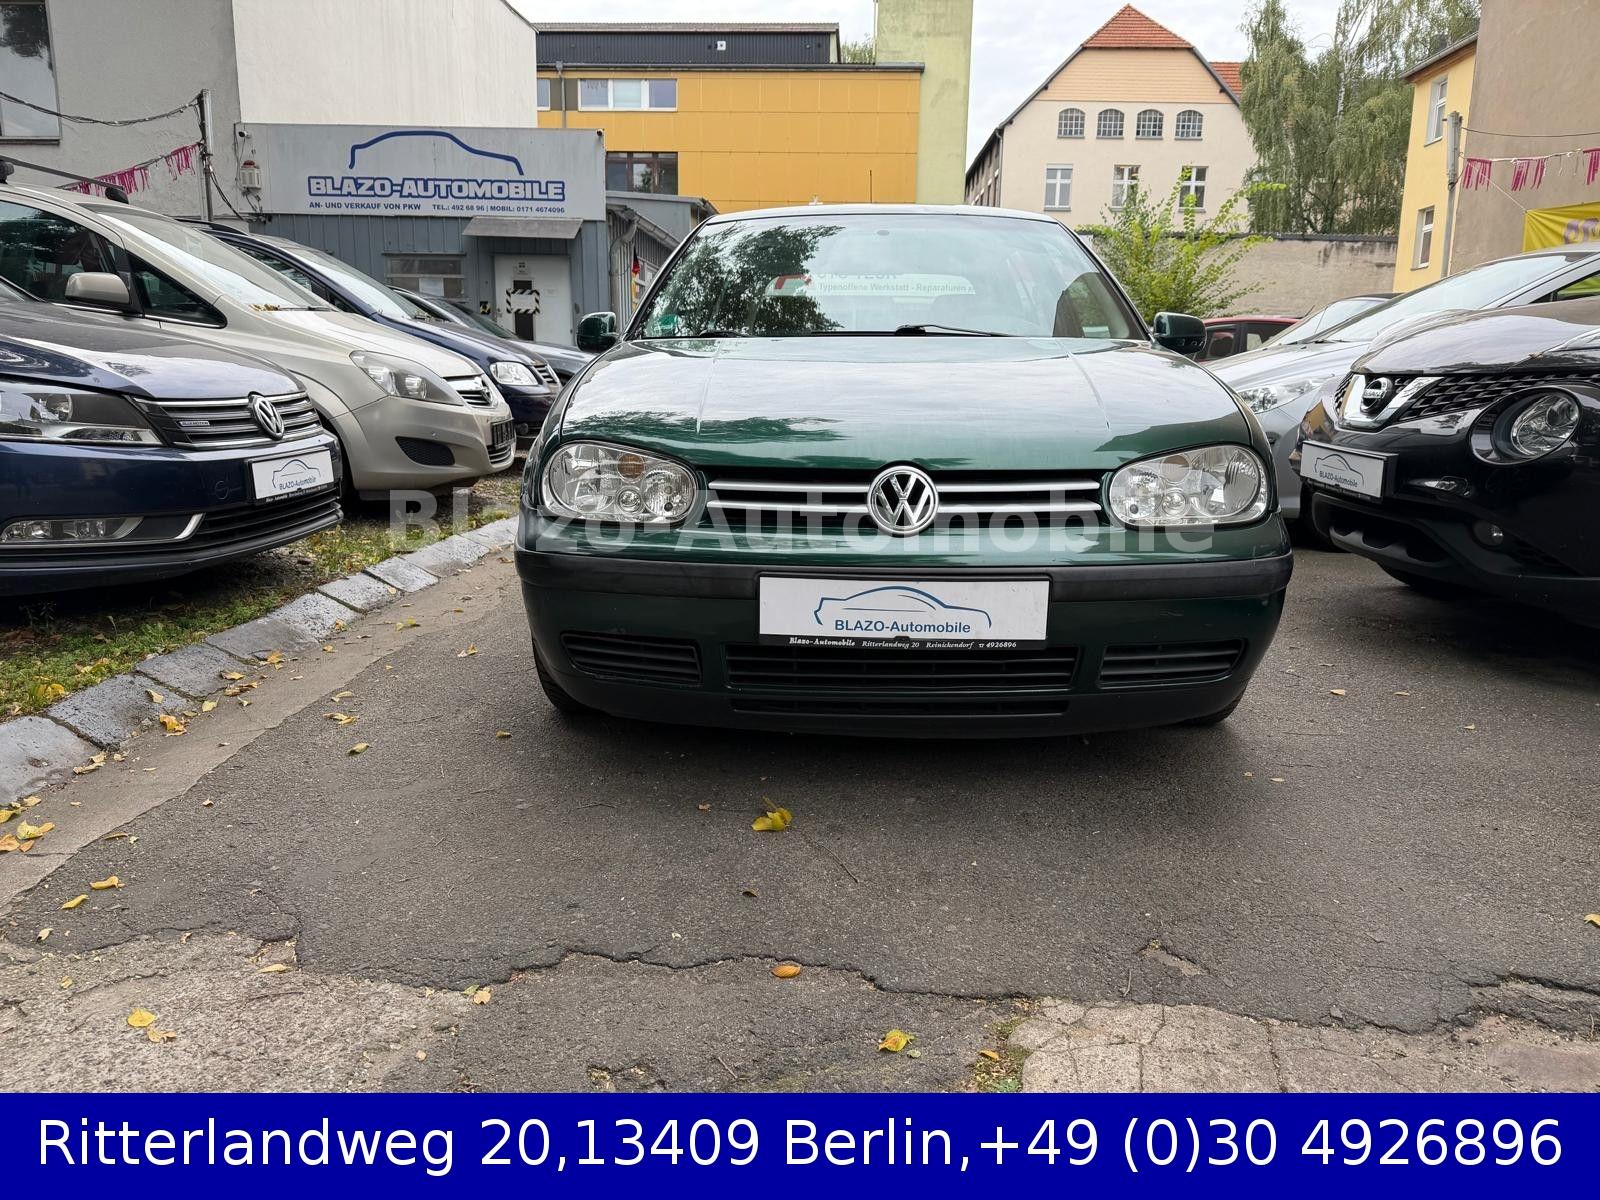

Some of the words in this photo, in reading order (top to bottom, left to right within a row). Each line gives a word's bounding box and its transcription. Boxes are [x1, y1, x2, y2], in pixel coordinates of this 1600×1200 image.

[308, 176, 565, 201] BLAZO-AUTOMOBILE
[344, 202, 381, 210] VERKAUF
[403, 203, 421, 211] PKW
[834, 619, 971, 633] BLAZO-Automobile
[789, 636, 856, 647] Blazo-Automobile
[861, 640, 910, 650] Ritterlandweg
[911, 641, 920, 649] 20
[926, 641, 975, 650] Reinickendorf
[985, 641, 1017, 649] 4926896
